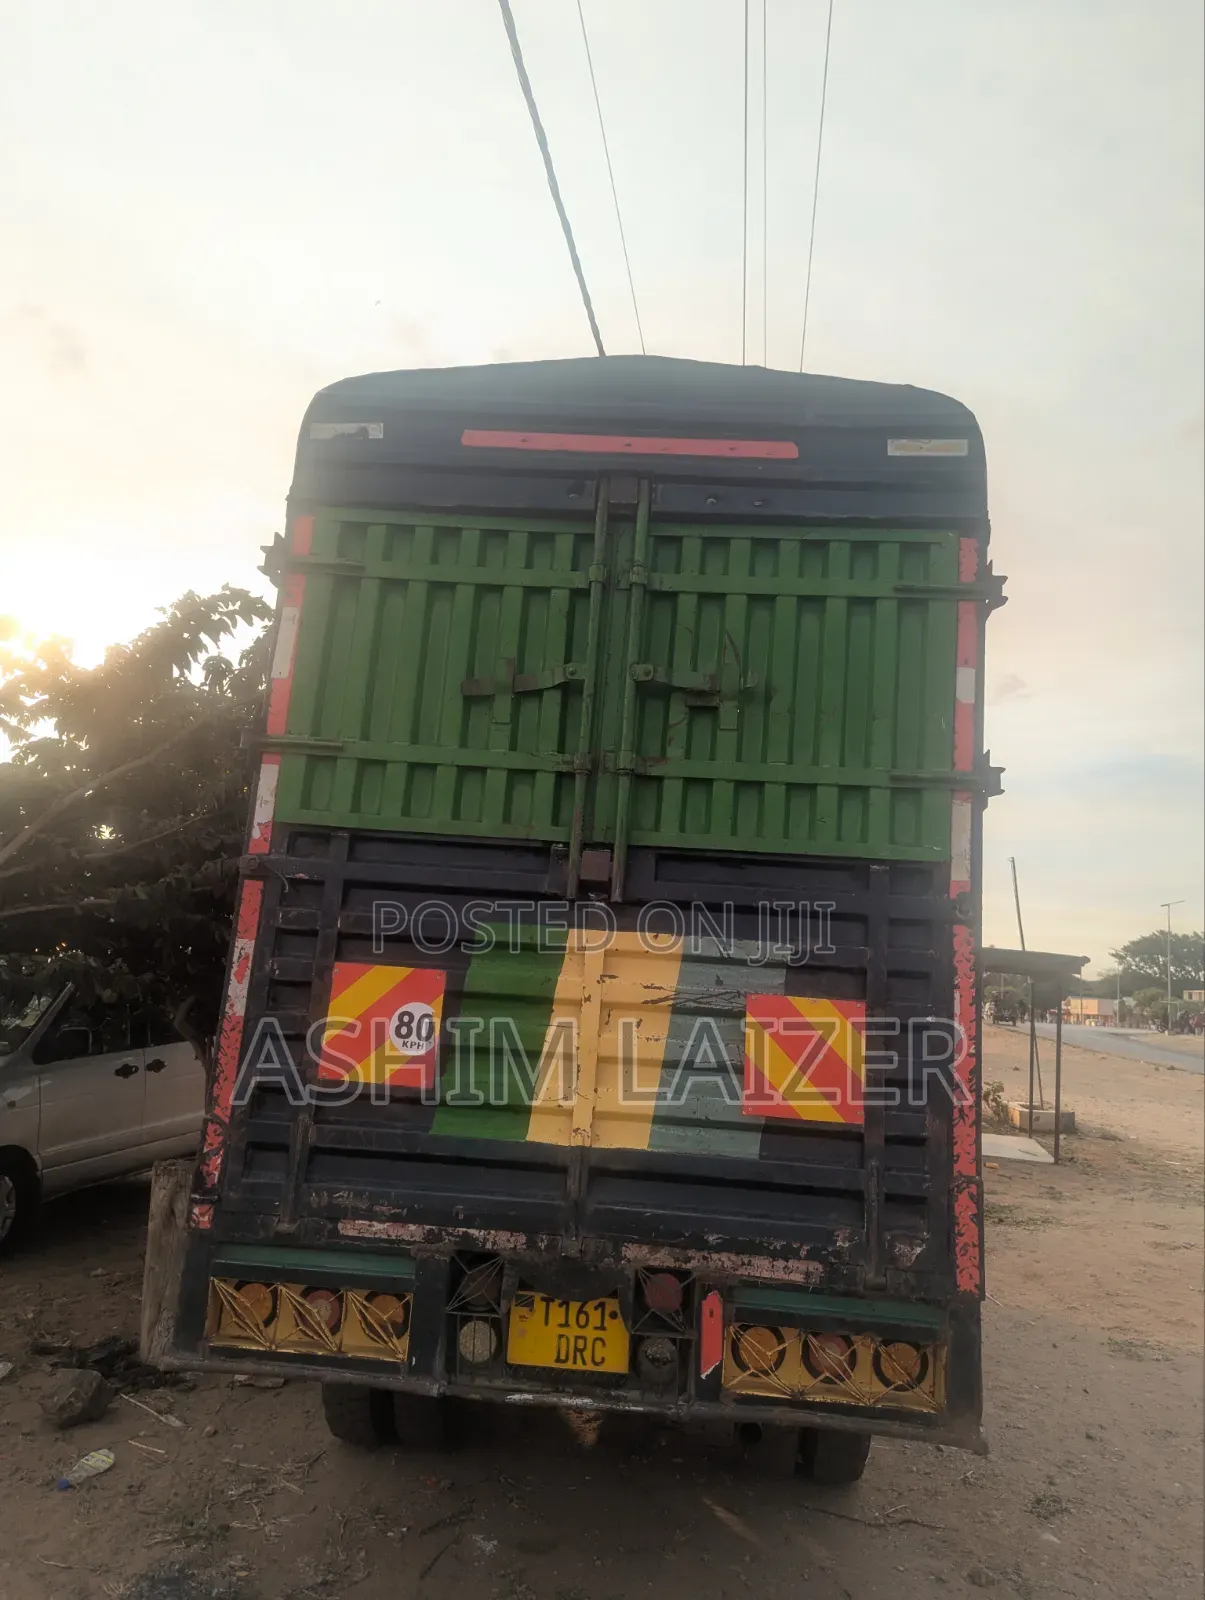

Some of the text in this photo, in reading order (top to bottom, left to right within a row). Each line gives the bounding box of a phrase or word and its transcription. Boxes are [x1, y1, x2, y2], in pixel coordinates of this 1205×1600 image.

[394, 1010, 434, 1042] 80
[401, 1040, 425, 1050] KPH
[540, 1296, 607, 1331] T161
[554, 1333, 606, 1367] DRC
